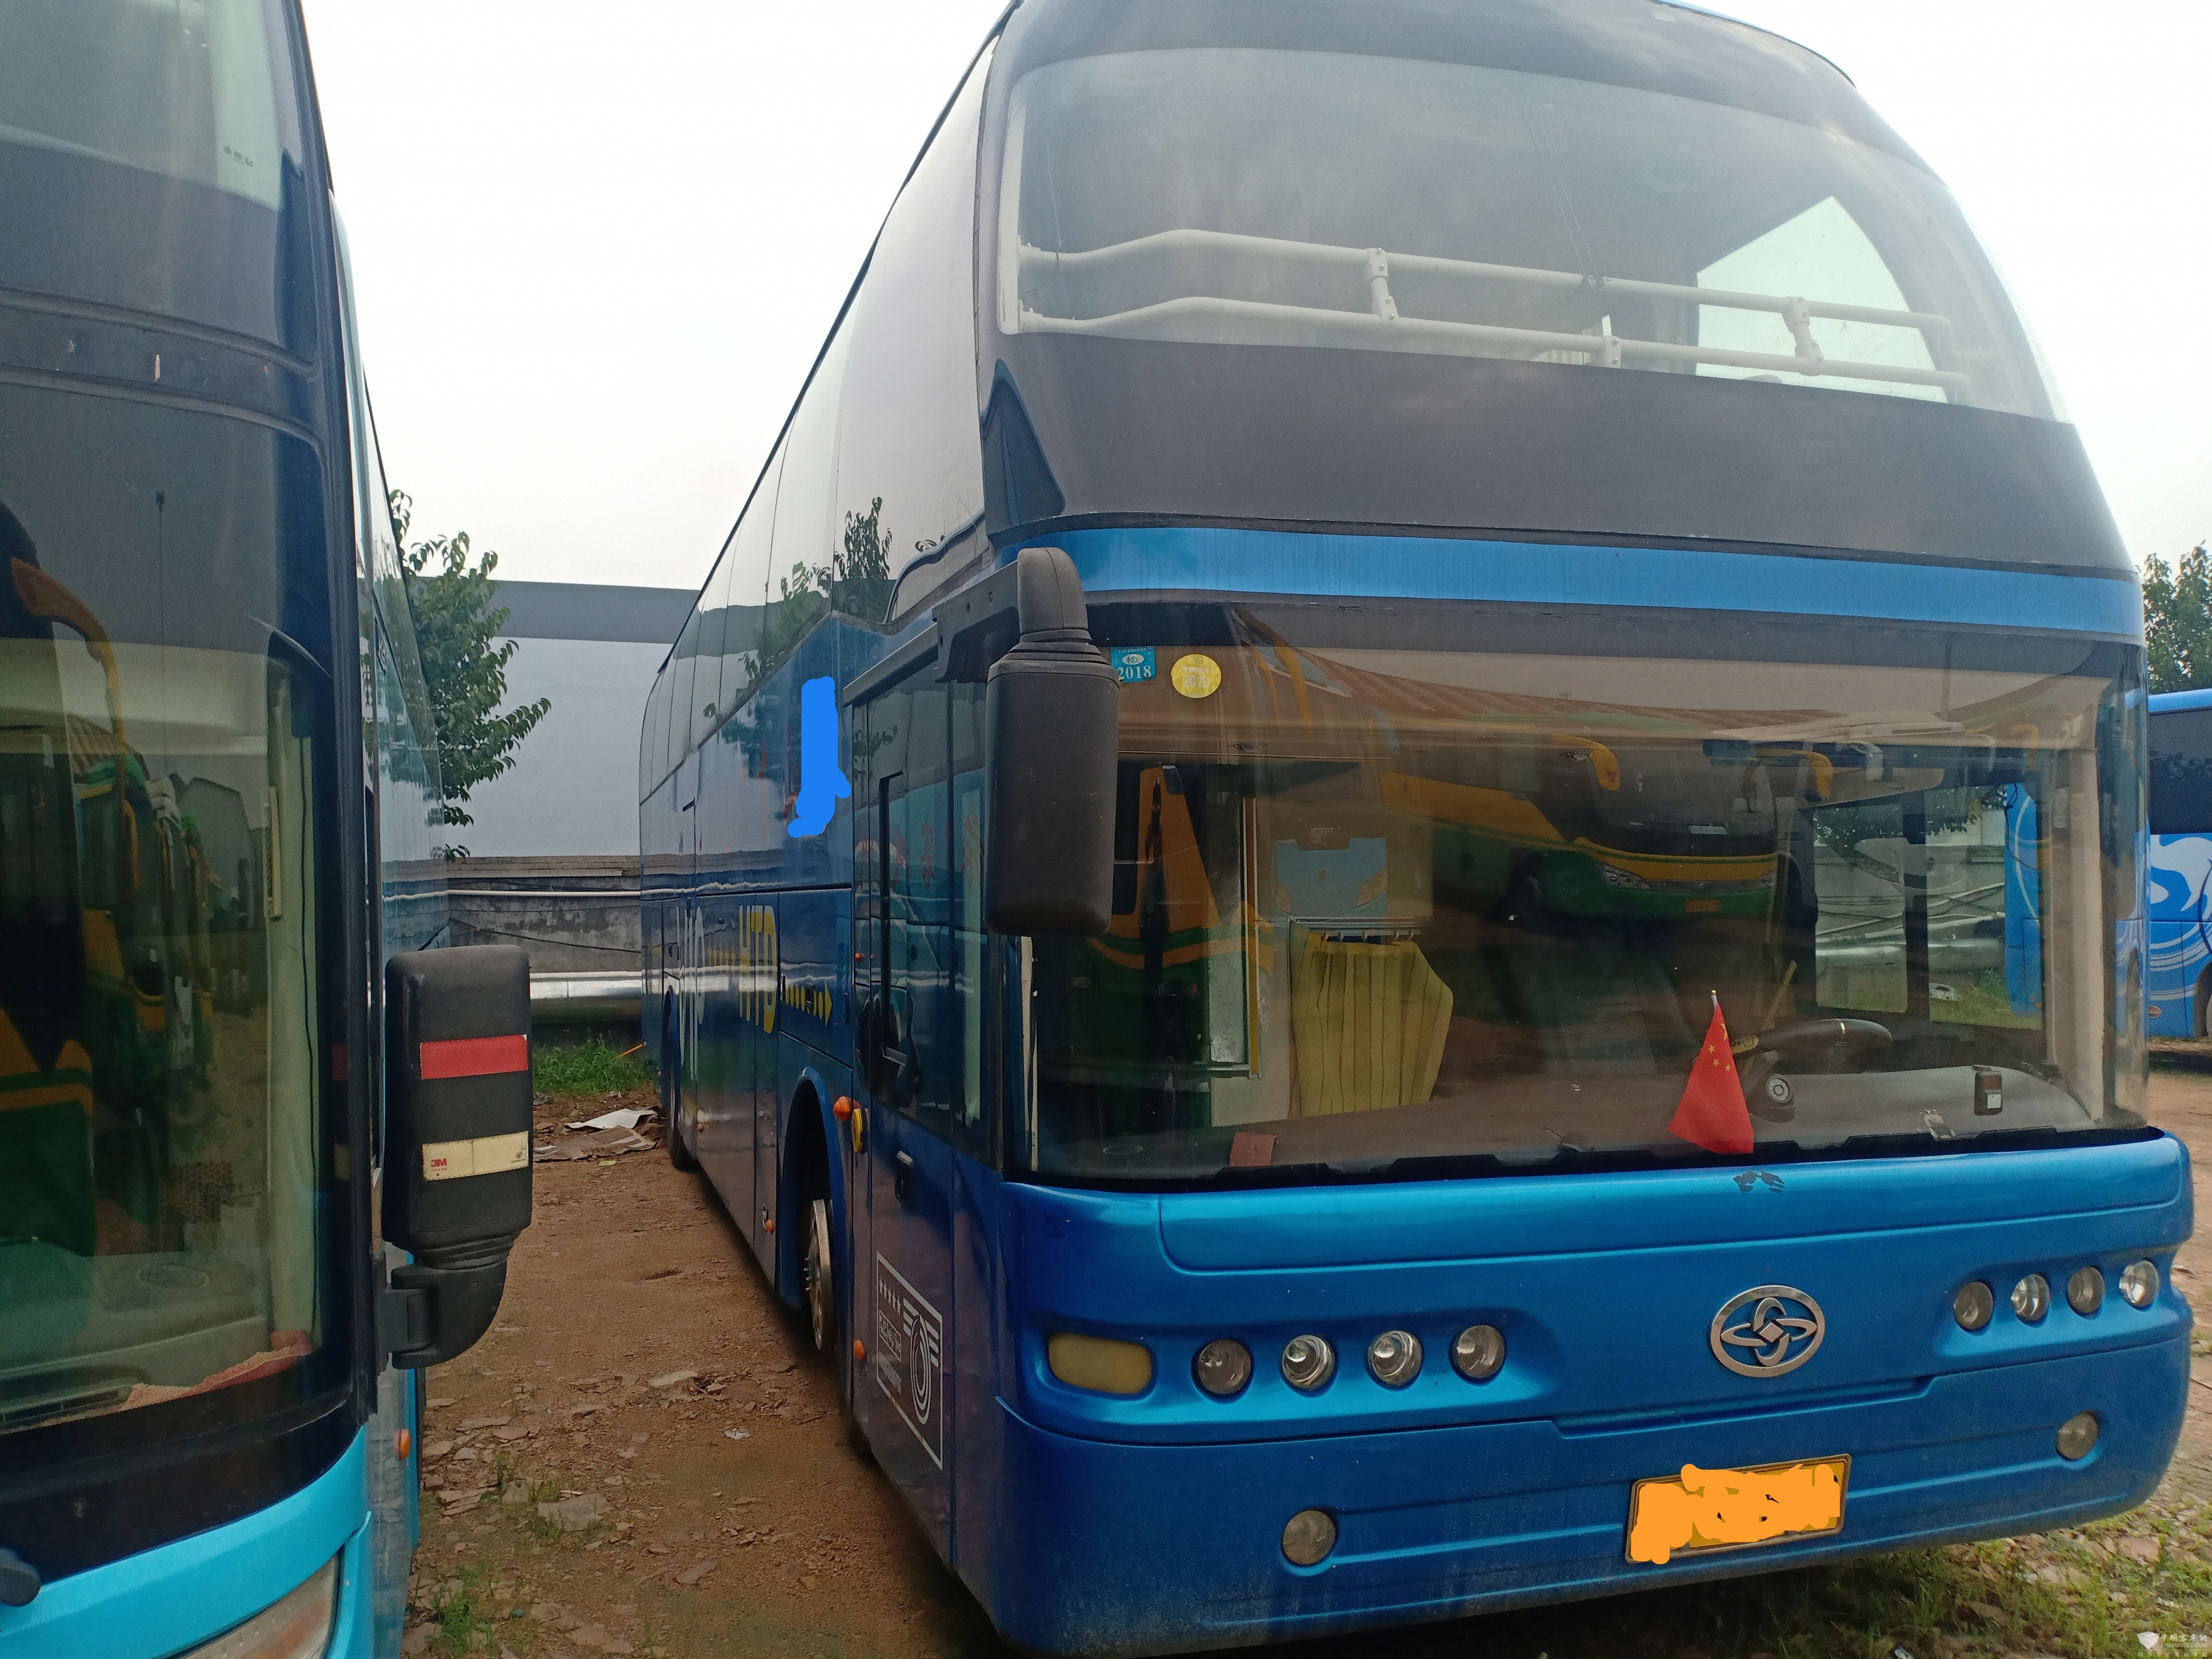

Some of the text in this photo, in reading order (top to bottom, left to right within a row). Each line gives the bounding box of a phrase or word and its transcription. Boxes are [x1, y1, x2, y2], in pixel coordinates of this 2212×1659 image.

[1126, 656, 1139, 664] 检
[1117, 665, 1152, 680] 2018
[1182, 675, 1210, 688] 2019
[739, 905, 778, 1034] HTD
[431, 1158, 447, 1167] 3M
